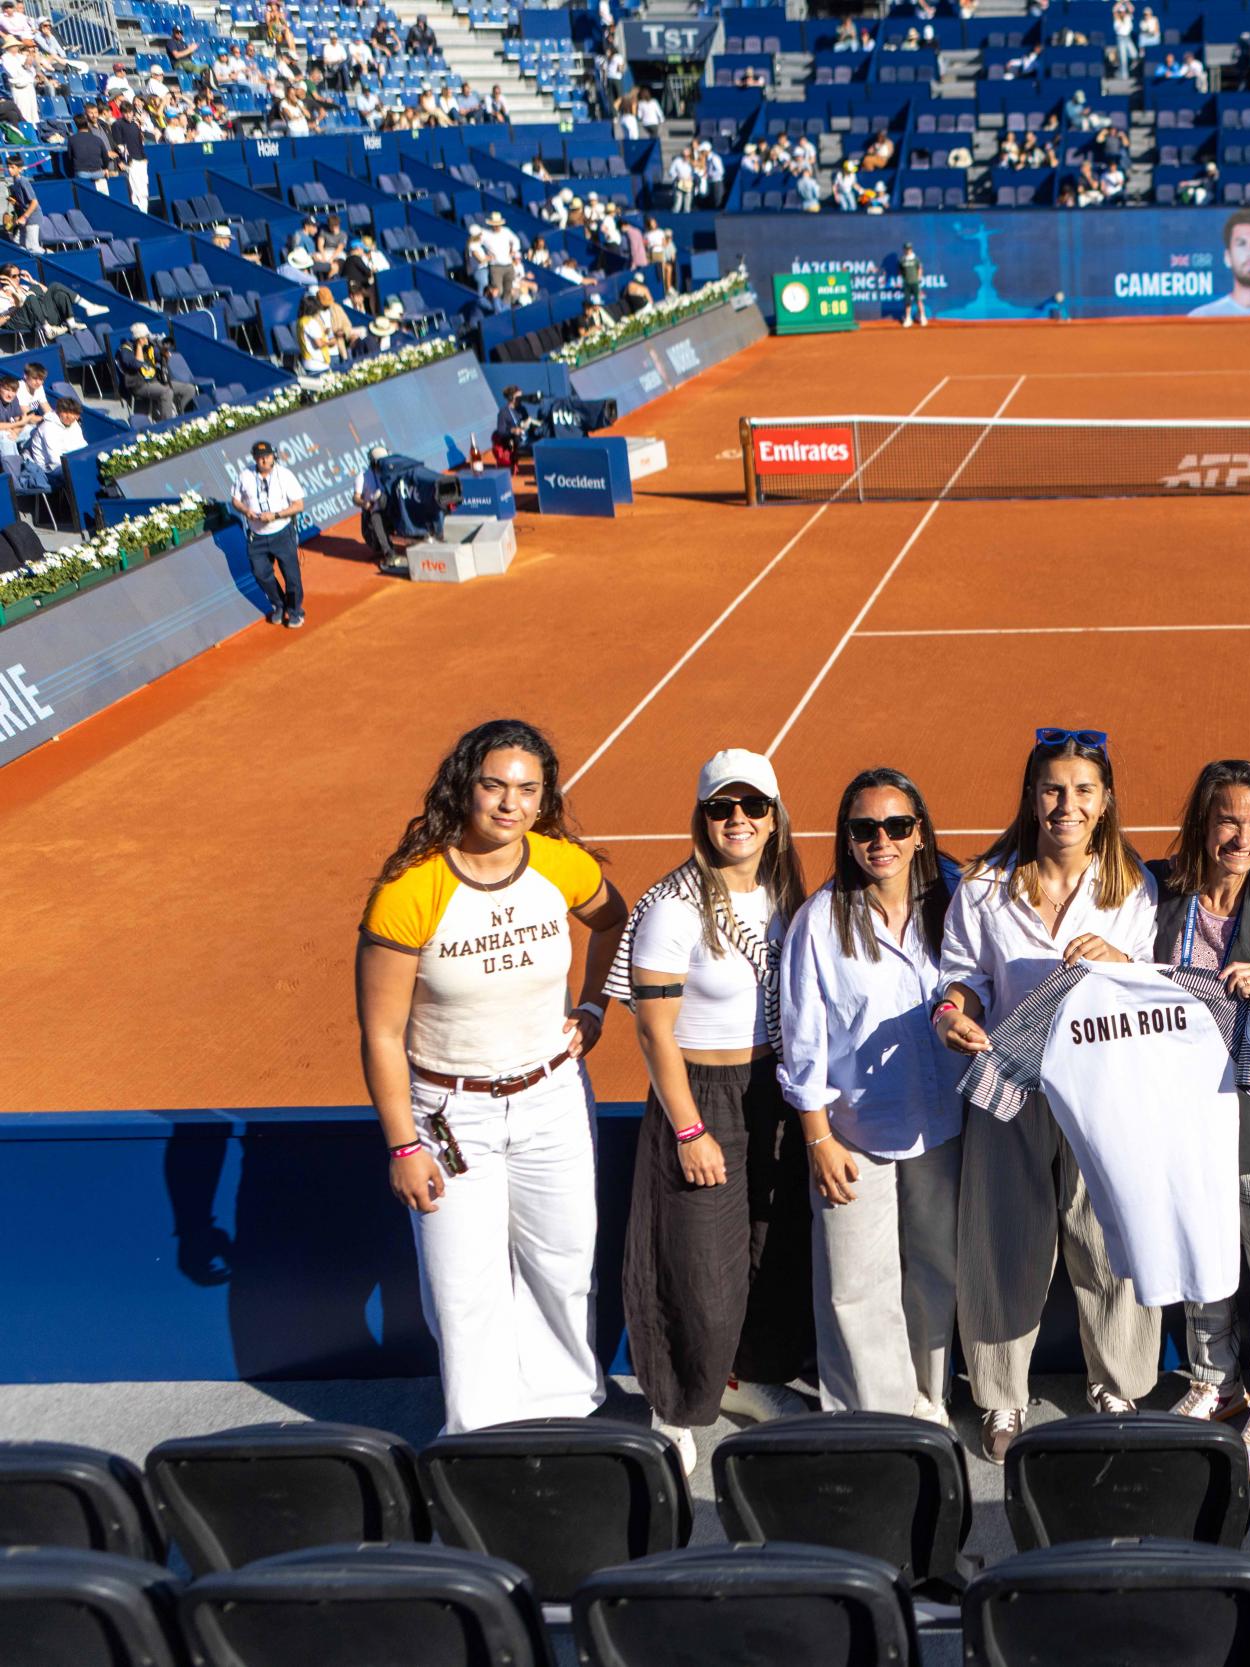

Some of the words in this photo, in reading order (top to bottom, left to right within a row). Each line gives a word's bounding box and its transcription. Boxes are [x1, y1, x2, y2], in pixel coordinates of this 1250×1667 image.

[257, 138, 280, 157] Haier
[1114, 271, 1213, 297] CAMERON
[758, 440, 850, 462] Emirates
[557, 473, 607, 490] Occident
[421, 559, 447, 574] rtve
[491, 906, 515, 927] NY
[438, 919, 561, 958] MANHATTAN
[482, 951, 534, 974] U.S.A
[1070, 1012, 1133, 1045] SONIA
[1137, 1005, 1188, 1036] ROIG
